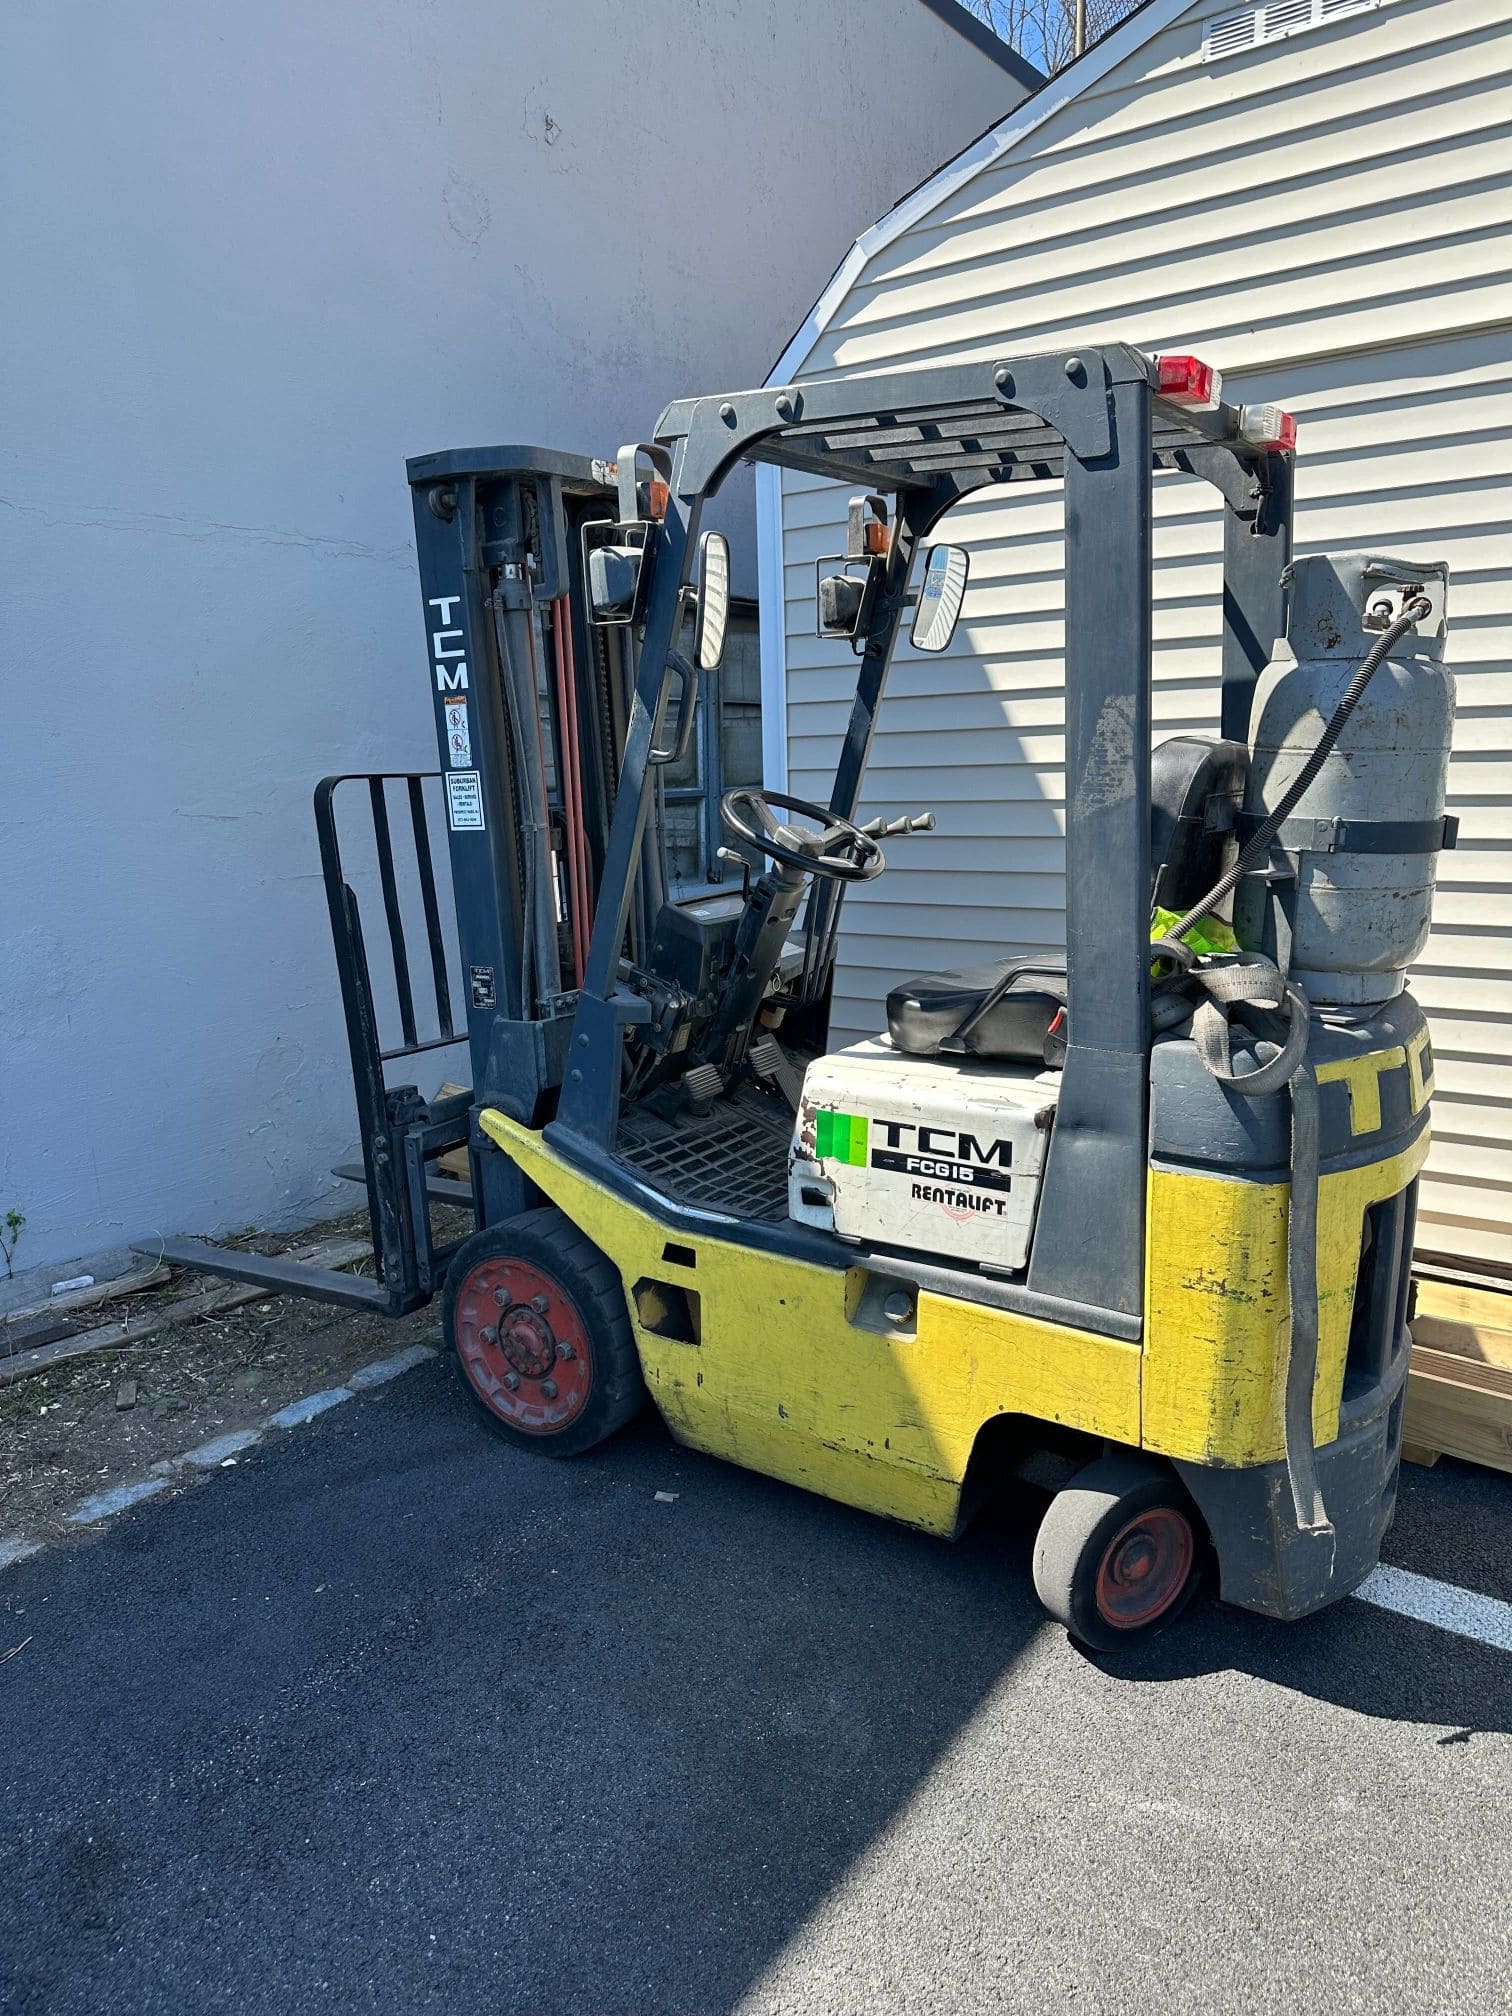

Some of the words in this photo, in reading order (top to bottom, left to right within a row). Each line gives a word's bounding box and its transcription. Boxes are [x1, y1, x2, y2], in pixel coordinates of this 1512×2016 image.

[428, 596, 469, 691] TCM
[872, 1118, 1013, 1168] TCM
[906, 1157, 974, 1182] FCG15
[911, 1183, 1007, 1216] RENTALIFT
